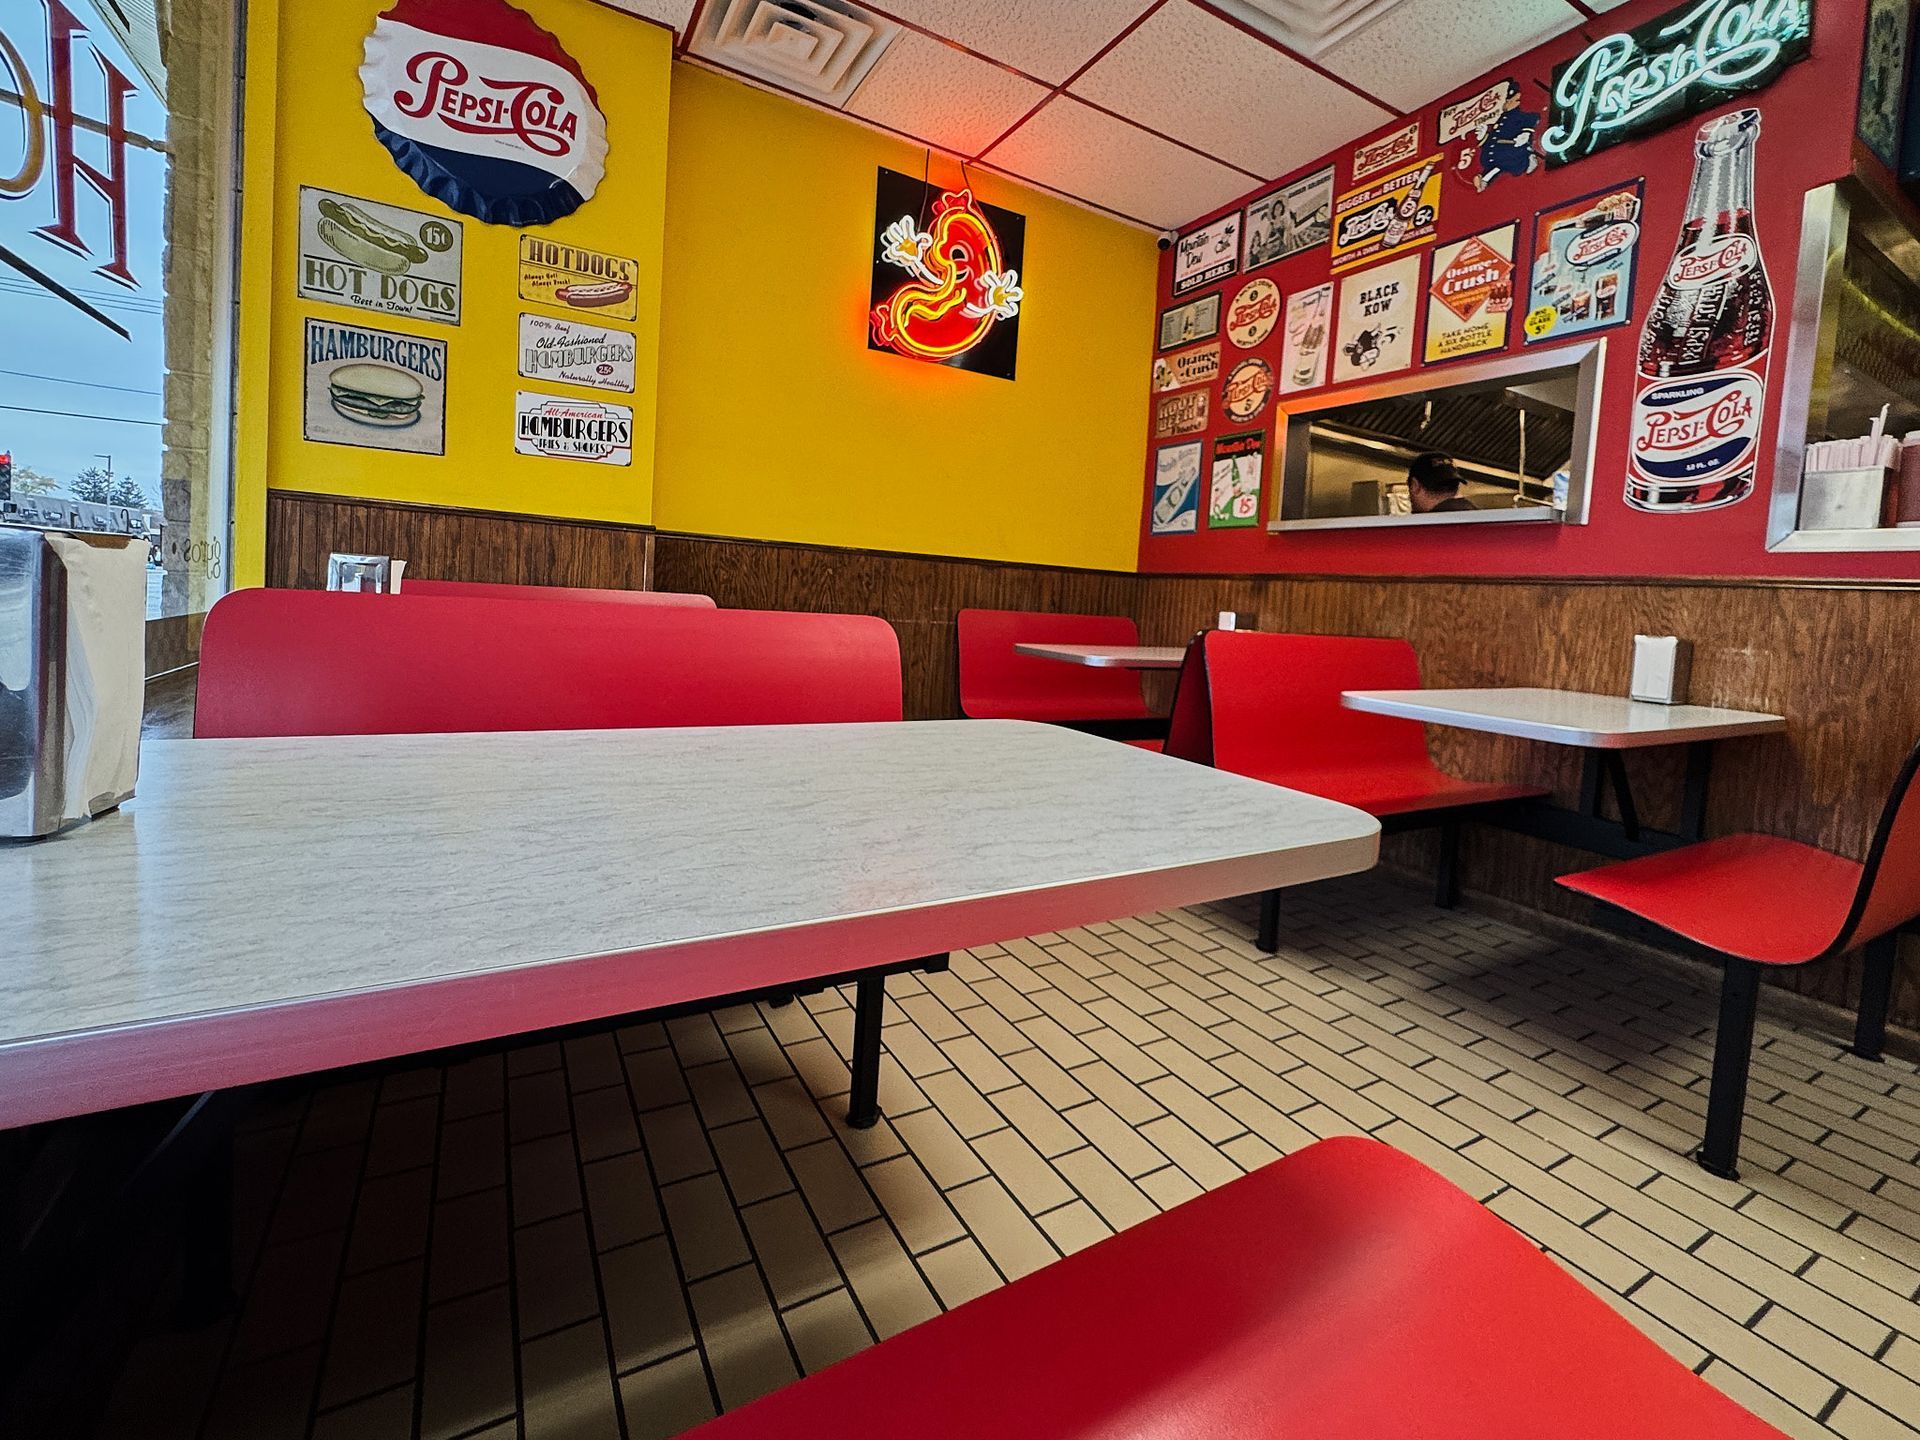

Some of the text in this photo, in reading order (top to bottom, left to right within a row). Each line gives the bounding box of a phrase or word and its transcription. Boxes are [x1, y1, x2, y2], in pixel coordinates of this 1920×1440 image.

[1336, 191, 1371, 213] BIGGER
[1383, 170, 1420, 194] BETTER
[305, 259, 456, 312] HOT DOGS
[1180, 274, 1204, 290] SOLD
[1442, 269, 1500, 295] Crush
[350, 294, 373, 307] Best
[1359, 282, 1400, 305] BLACK
[1363, 298, 1393, 317] KOW
[529, 319, 552, 329] 100%
[1442, 322, 1489, 339] TAKE HOME
[535, 333, 607, 349] Old-Fashioned
[1459, 330, 1492, 343] BOTTLE
[310, 325, 442, 381] HAMBURGERS
[558, 371, 630, 391] Naturally Healthy
[1651, 387, 1705, 400] SPARKLING
[543, 407, 604, 419] All-American
